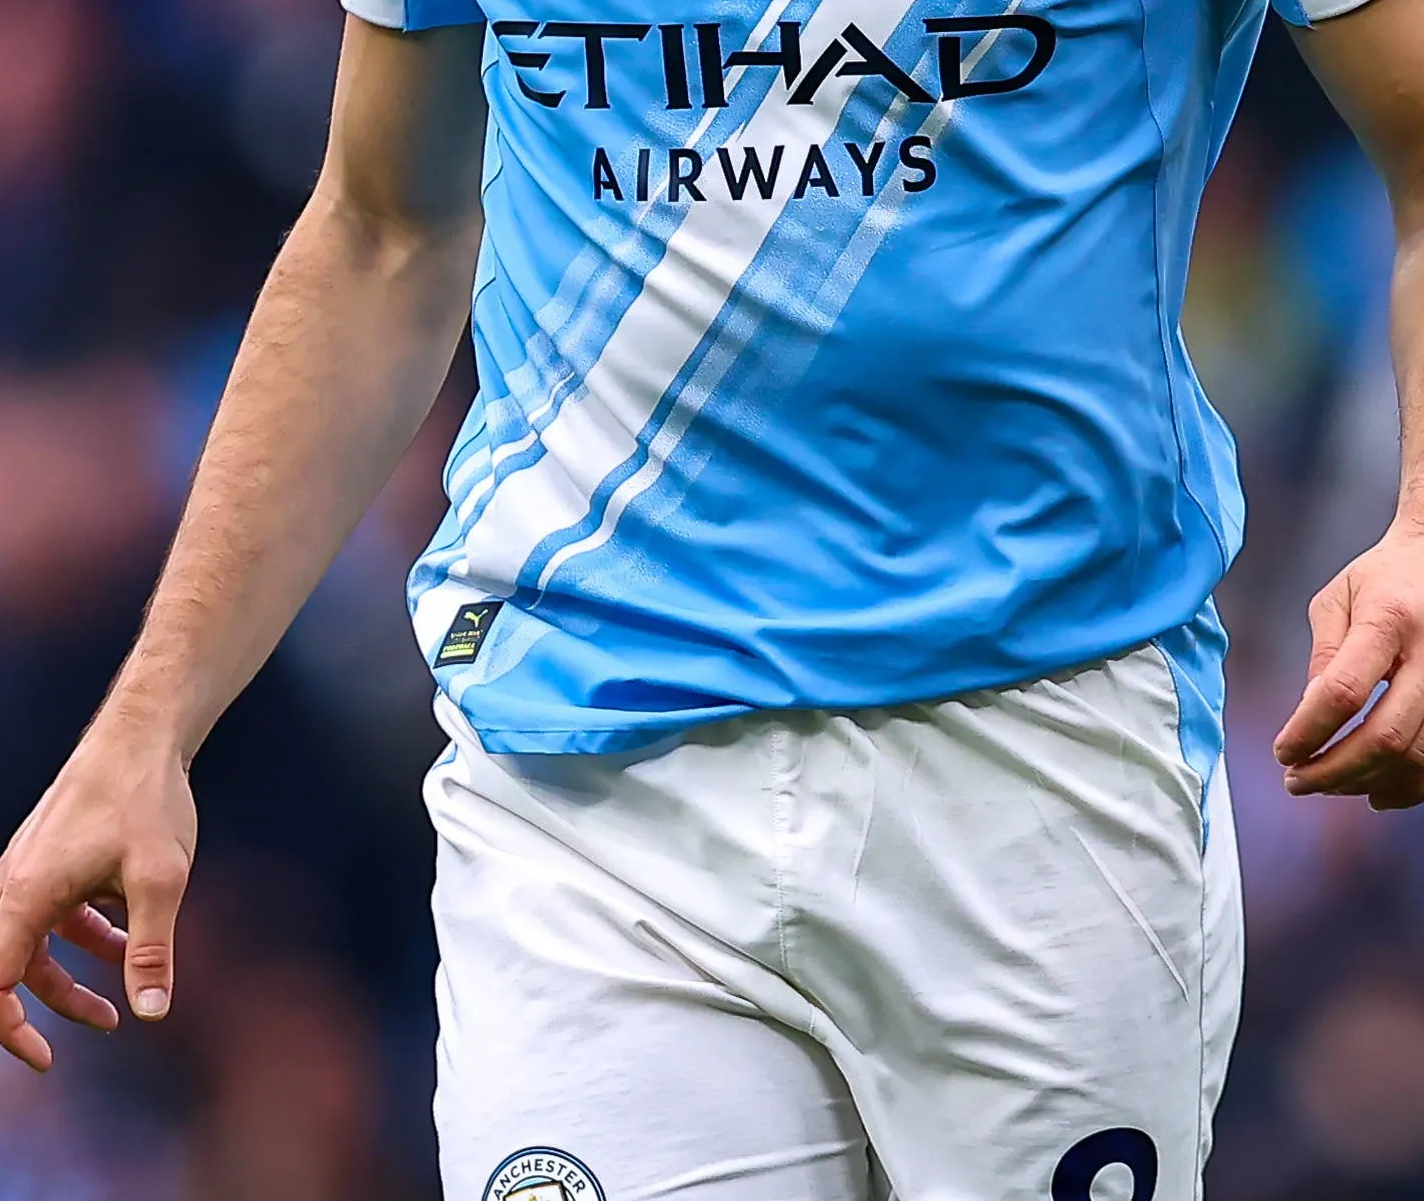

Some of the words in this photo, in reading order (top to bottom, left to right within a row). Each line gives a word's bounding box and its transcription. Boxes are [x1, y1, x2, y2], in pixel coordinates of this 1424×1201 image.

[490, 14, 1056, 110] ETIHAD
[592, 135, 937, 202] AIRWAYS
[493, 1158, 586, 1201] ANCHESTER
